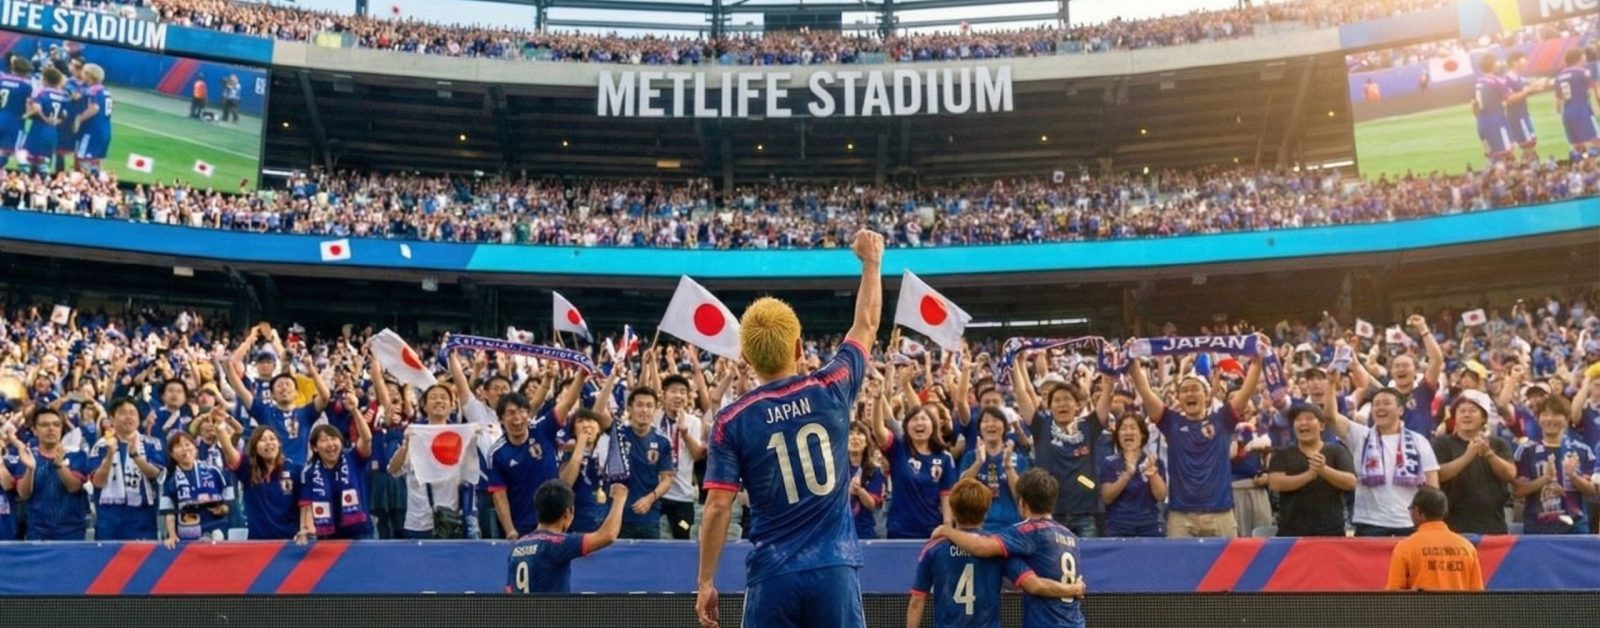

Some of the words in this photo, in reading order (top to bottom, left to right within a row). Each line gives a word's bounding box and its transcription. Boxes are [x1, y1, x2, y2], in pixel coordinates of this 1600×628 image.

[2, 0, 43, 30] IFE
[52, 8, 167, 50] STADIUM
[597, 71, 792, 117] METLIFE
[807, 65, 1014, 117] STADIUM
[1163, 335, 1247, 351] JAPAN
[766, 397, 811, 424] JAPAN
[766, 422, 836, 505] 10
[516, 561, 530, 594] 9
[953, 563, 976, 615] 4
[1060, 552, 1077, 603] 8
